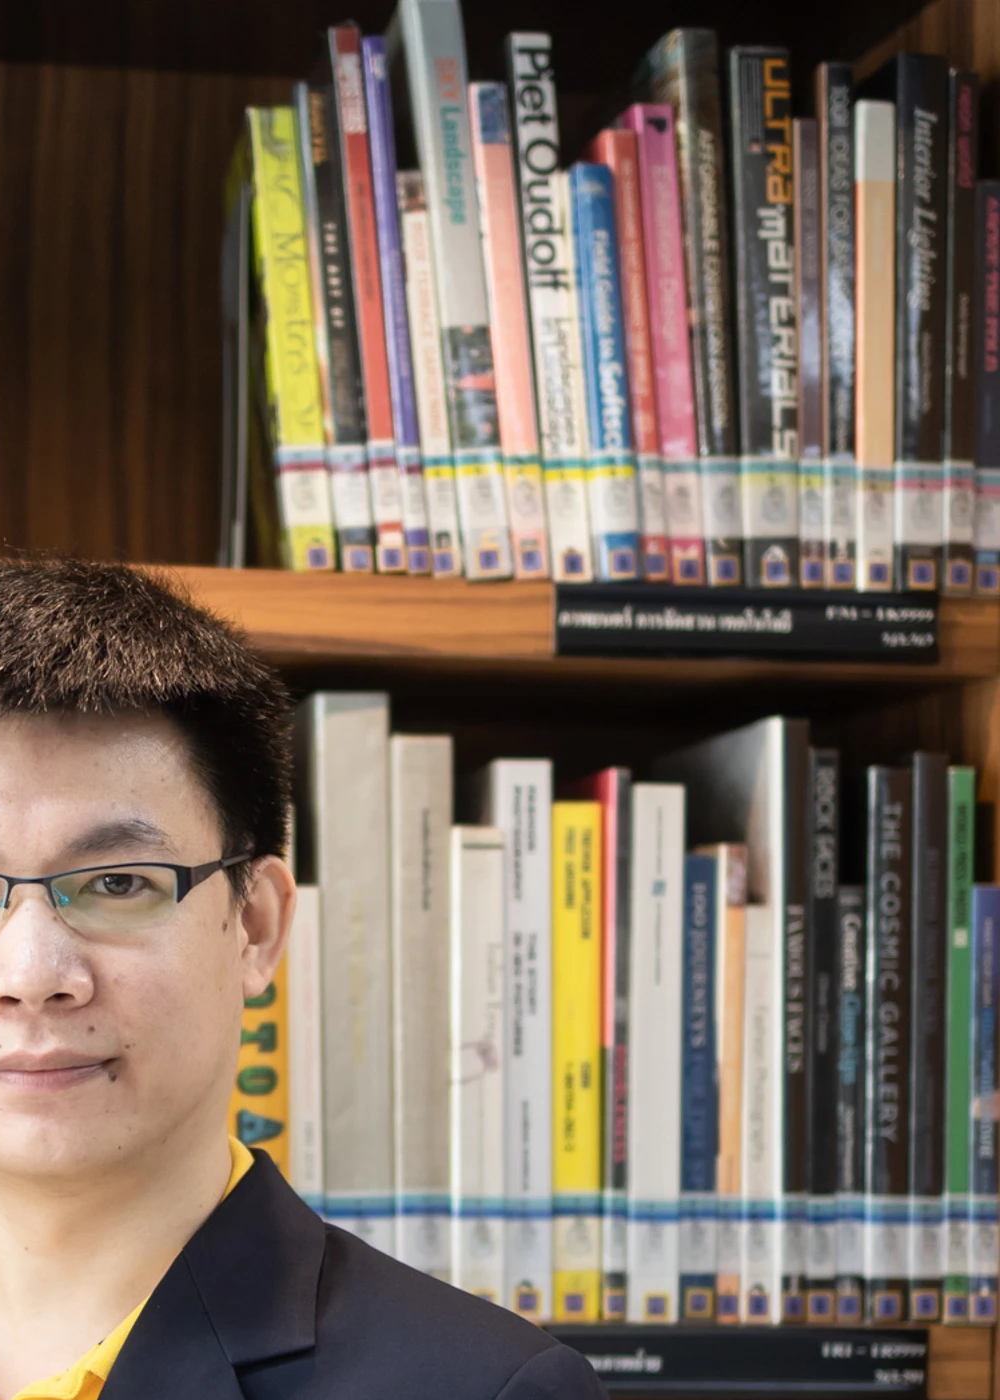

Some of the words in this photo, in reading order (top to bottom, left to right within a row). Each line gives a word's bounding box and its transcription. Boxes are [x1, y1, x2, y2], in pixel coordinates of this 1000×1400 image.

[518, 44, 554, 127] Piet
[440, 106, 466, 225] Landscape
[700, 129, 718, 250] AFFORDABLE
[913, 106, 937, 203] Interior
[524, 139, 570, 292] Oudolf
[599, 360, 626, 456] Softsc
[880, 800, 901, 859] THE
[691, 881, 707, 927] 100
[841, 913, 860, 991] Creative
[879, 871, 899, 995] COSMIC
[690, 930, 708, 1048] JOURNEYS
[879, 1005, 899, 1145] GALLERY
